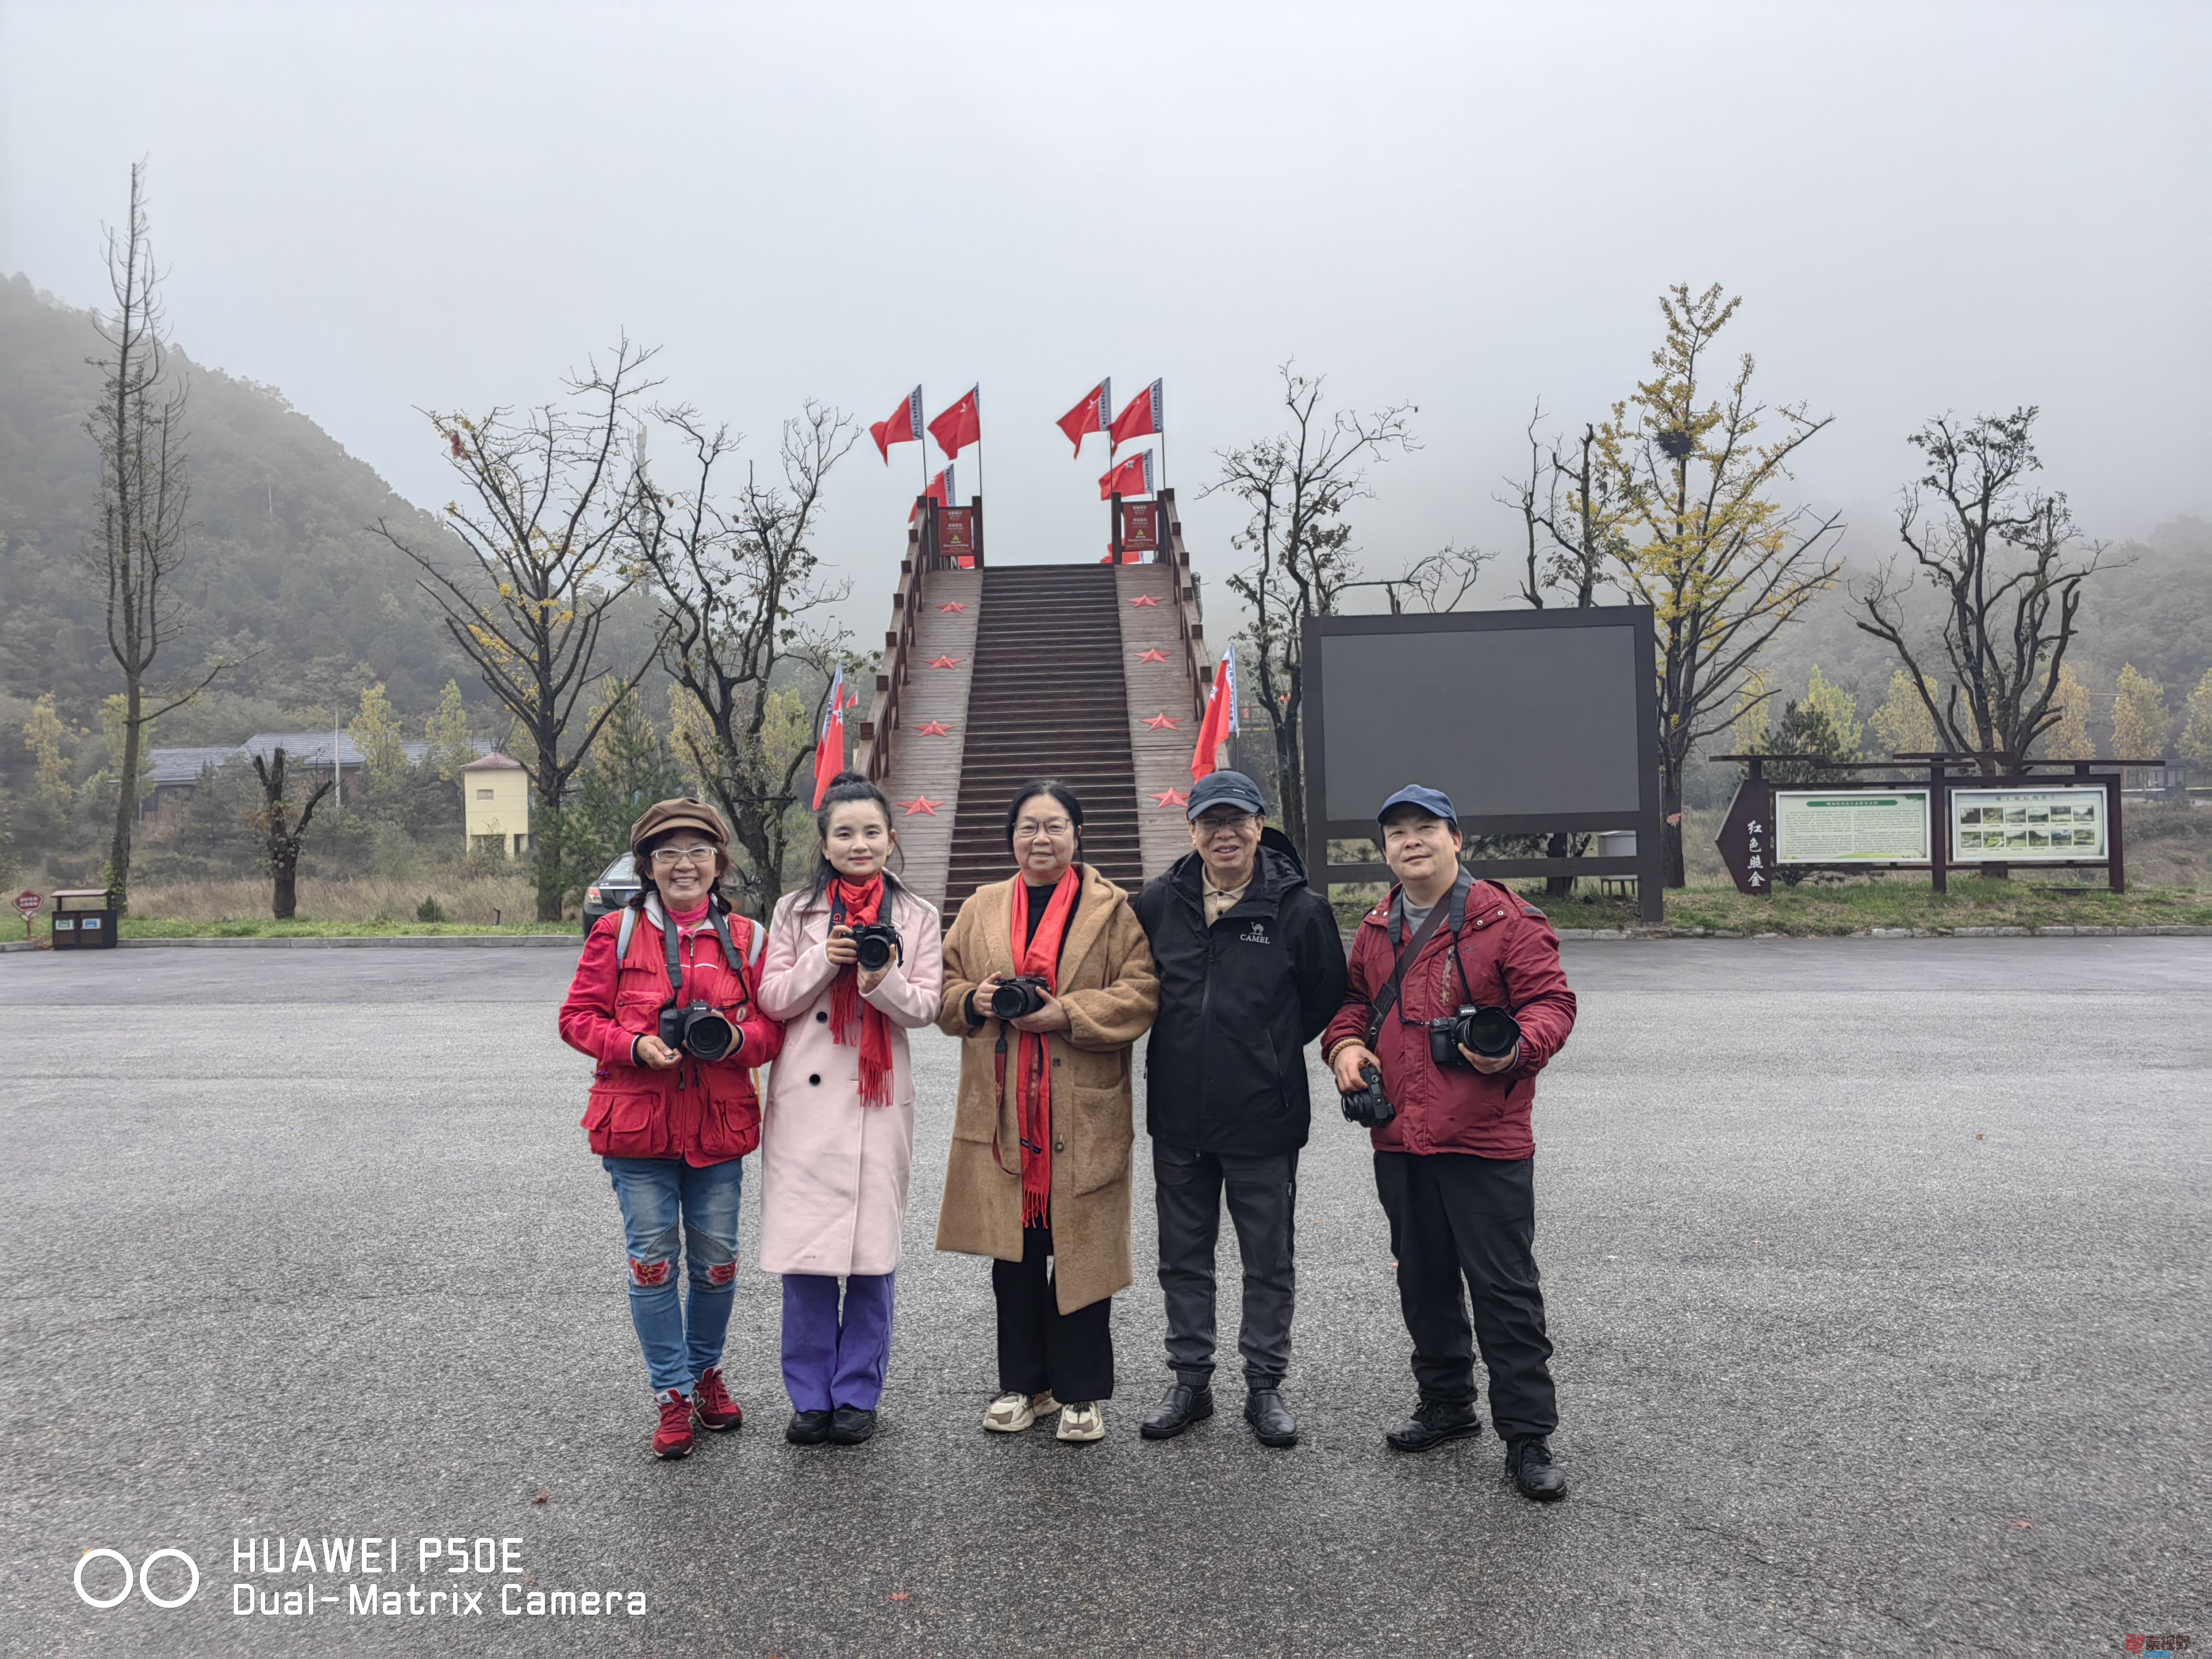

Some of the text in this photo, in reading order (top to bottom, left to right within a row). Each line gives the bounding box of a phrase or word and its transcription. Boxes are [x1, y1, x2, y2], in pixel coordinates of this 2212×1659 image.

[1748, 820, 1765, 887] 红色照金
[1240, 934, 1270, 944] CAMEL
